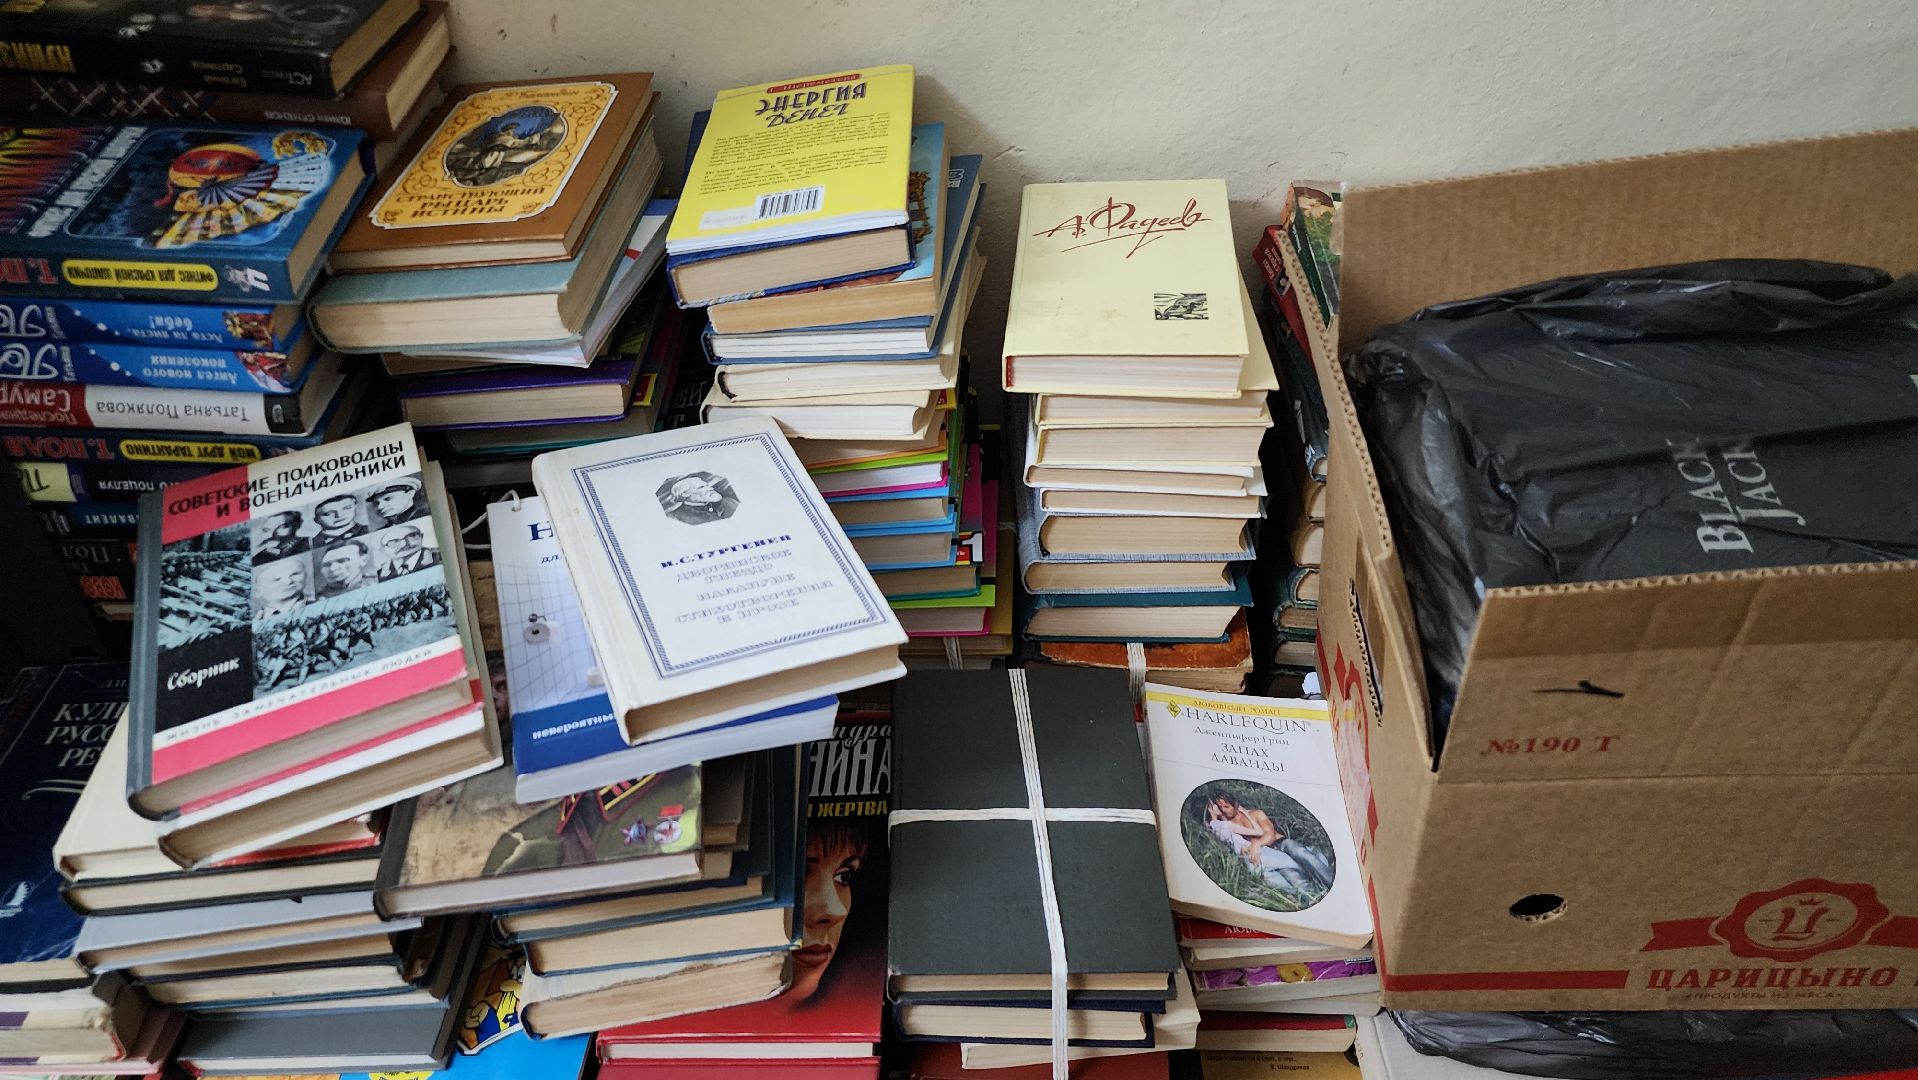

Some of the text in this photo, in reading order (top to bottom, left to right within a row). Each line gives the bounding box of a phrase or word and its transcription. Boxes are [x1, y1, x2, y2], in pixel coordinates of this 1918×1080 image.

[755, 82, 867, 116] ЭНЕРГИЯ
[766, 101, 850, 128] ДЕНЕГ
[396, 186, 547, 203] СТРАНСТВУЮЩИЙ
[420, 197, 510, 210] РЫЦАРЬ
[409, 205, 506, 218] ИСТИНЫ
[67, 265, 214, 282] ФИТНЕС ДЛЯ КРАСНОЙ ШАПОЧКИ
[150, 315, 193, 330] беби!
[174, 331, 189, 341] ла
[192, 331, 224, 343] Аста
[151, 354, 226, 369] поколения
[143, 367, 238, 385] Ангел нового
[96, 400, 249, 422] Татьяна Полякова
[125, 443, 257, 460] МОЙ ДРУГ ТАРАНТИНО
[99, 479, 154, 491] ПОЦЕЛУЯ
[168, 440, 404, 517] СОВЕТСКИЕ ПОЛКОВОДЦЫ
[215, 455, 407, 519] И ВОЕНАЧАЛЬНИКИ
[85, 513, 138, 525] ВАЛЕНТ
[61, 545, 110, 564] Пол
[541, 554, 561, 567] дл
[677, 550, 792, 583] ДВОРЯНСКОЕ
[705, 564, 773, 584] ГНЕЗДО
[697, 573, 796, 600] НАКАНУНЕ
[675, 579, 834, 624] СТИХОТВОРЕНИЯ
[718, 598, 800, 625] В ПРОЗЕ
[167, 657, 240, 692] Сборник
[165, 648, 433, 743] ЖИЗНЬ ЗАМЕЧАТЕЛЬНЫХ ЛЮДЕЙ
[1193, 700, 1247, 715] ЛЮБОВНЫЙ
[1185, 707, 1308, 735] HARLEQUIN
[1194, 725, 1290, 748] Дженнифер Грин
[1480, 735, 1581, 756] №190
[57, 747, 104, 767] РЕ
[1220, 742, 1270, 759] ЗАПАХ
[1211, 752, 1287, 773] ЛАВАНДЫ
[817, 801, 888, 818] ЖЕРТВА
[1646, 967, 1899, 992] ЦАРИЦЫНО
